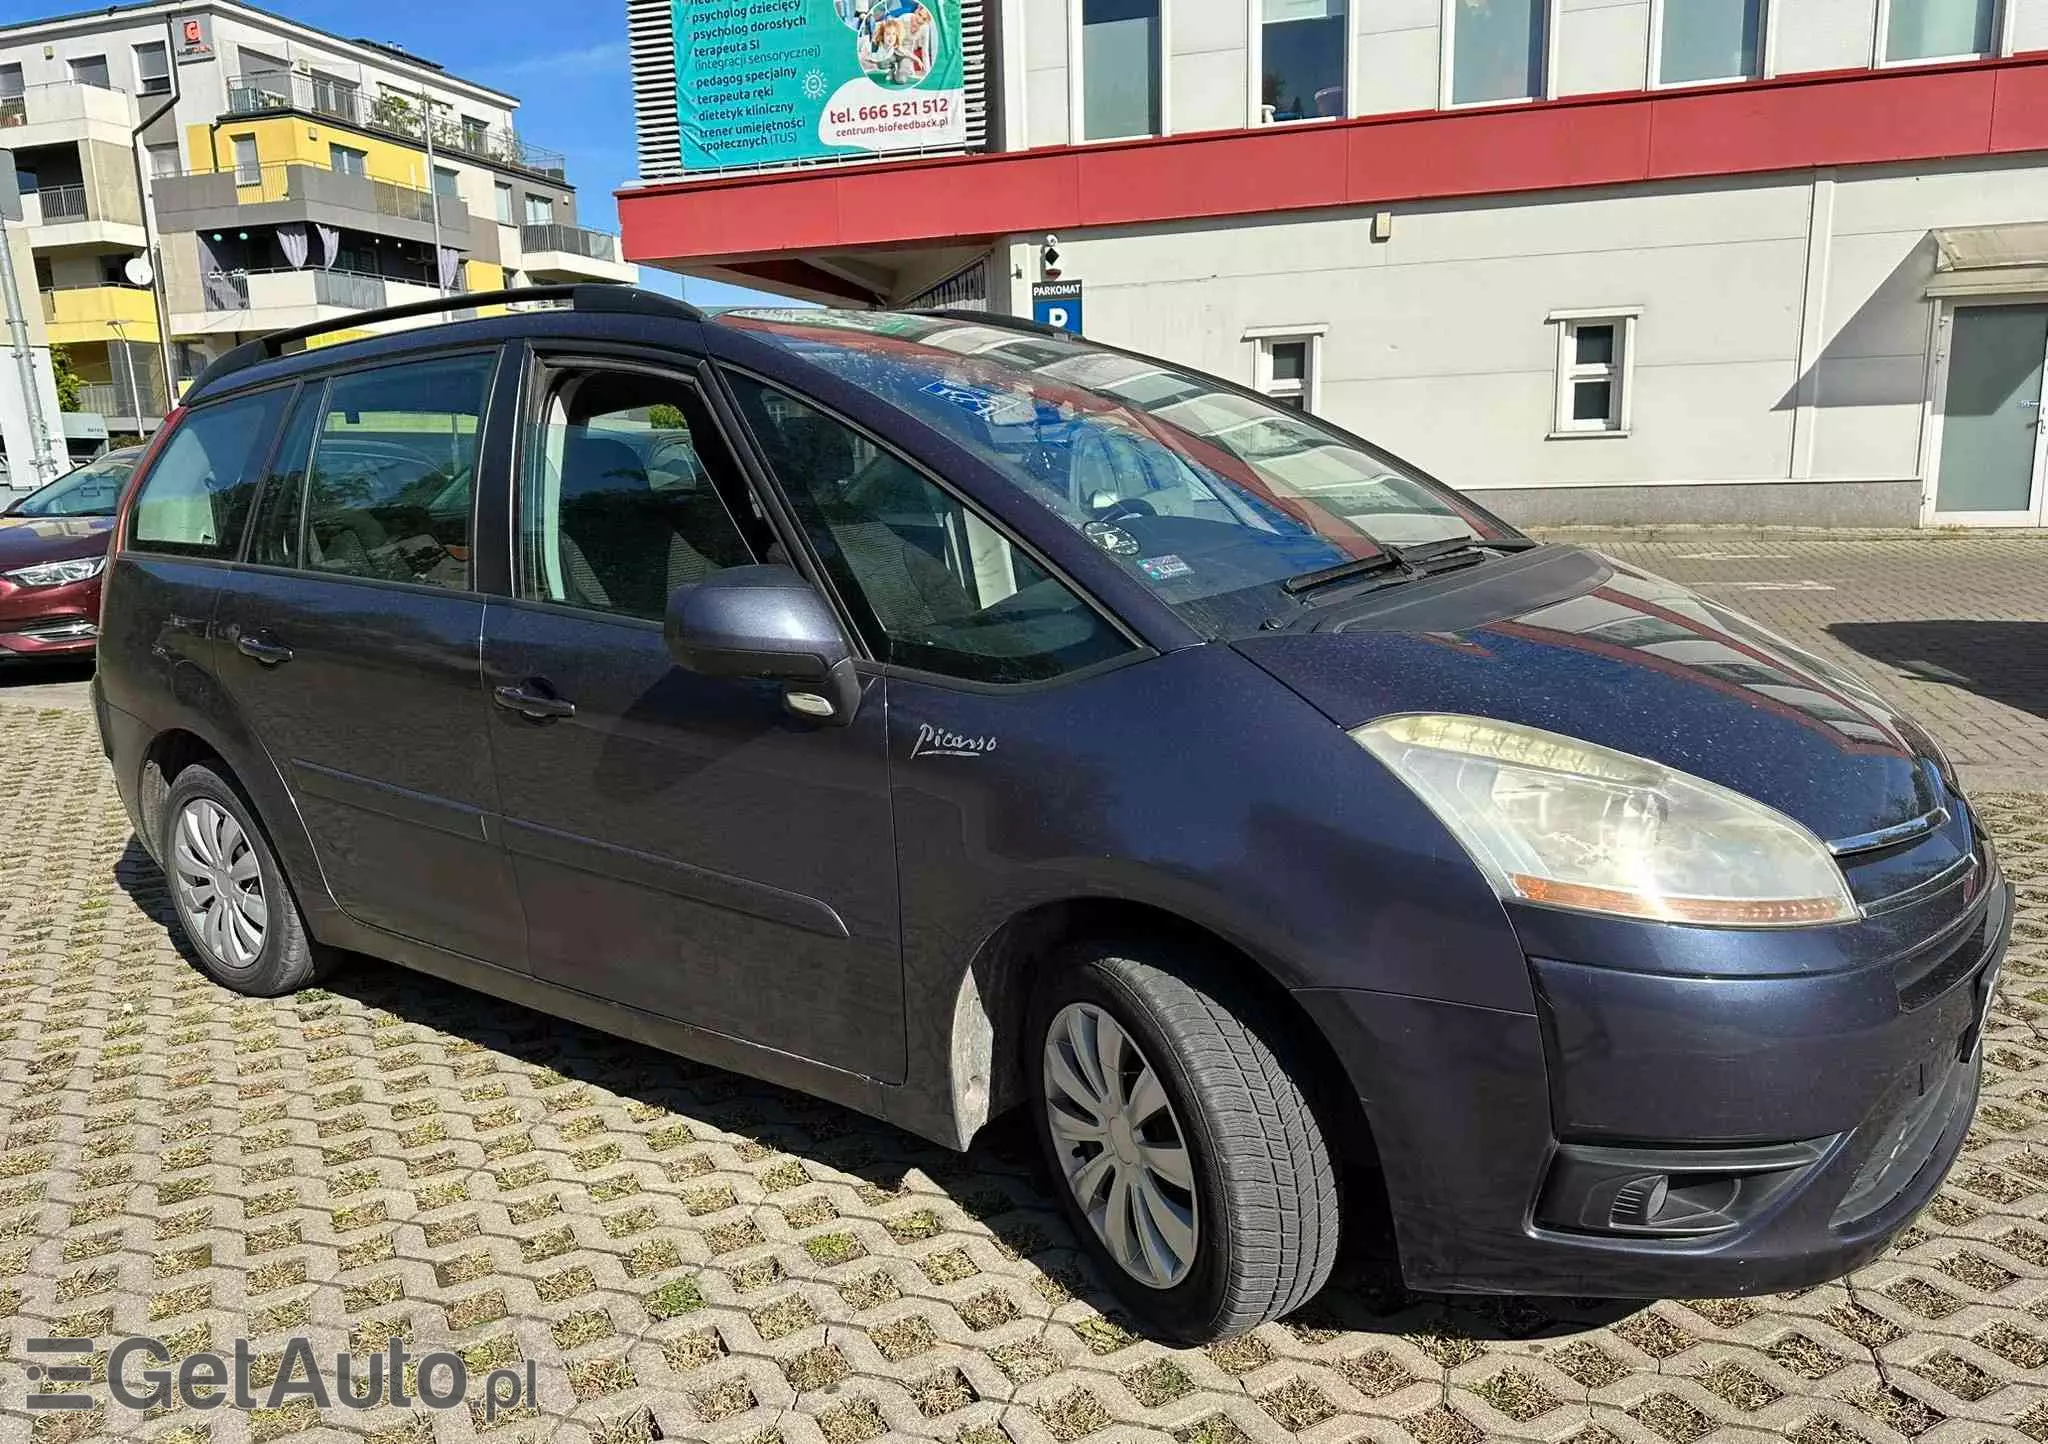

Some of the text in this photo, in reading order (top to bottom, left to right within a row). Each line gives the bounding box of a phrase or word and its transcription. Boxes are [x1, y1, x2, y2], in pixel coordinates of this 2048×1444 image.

[693, 0, 801, 24] psycholog dziecięcy
[693, 15, 807, 41] psycholog dorosłych
[694, 42, 748, 57] terapeuta
[695, 45, 821, 71] (integracji sensorycznej)
[696, 66, 797, 89] pedagog specjalny
[697, 86, 774, 104] terapeuta ręki
[698, 103, 795, 121] dietetyk kliniczny
[830, 98, 948, 124] tel. 666 521 512
[700, 116, 806, 138] trener umiejętności
[836, 116, 948, 137] centrum-biofeedback.pl
[700, 132, 798, 152] społecznych (TUS)
[1033, 284, 1080, 296] PARKOMAT
[910, 722, 997, 760] Picasso
